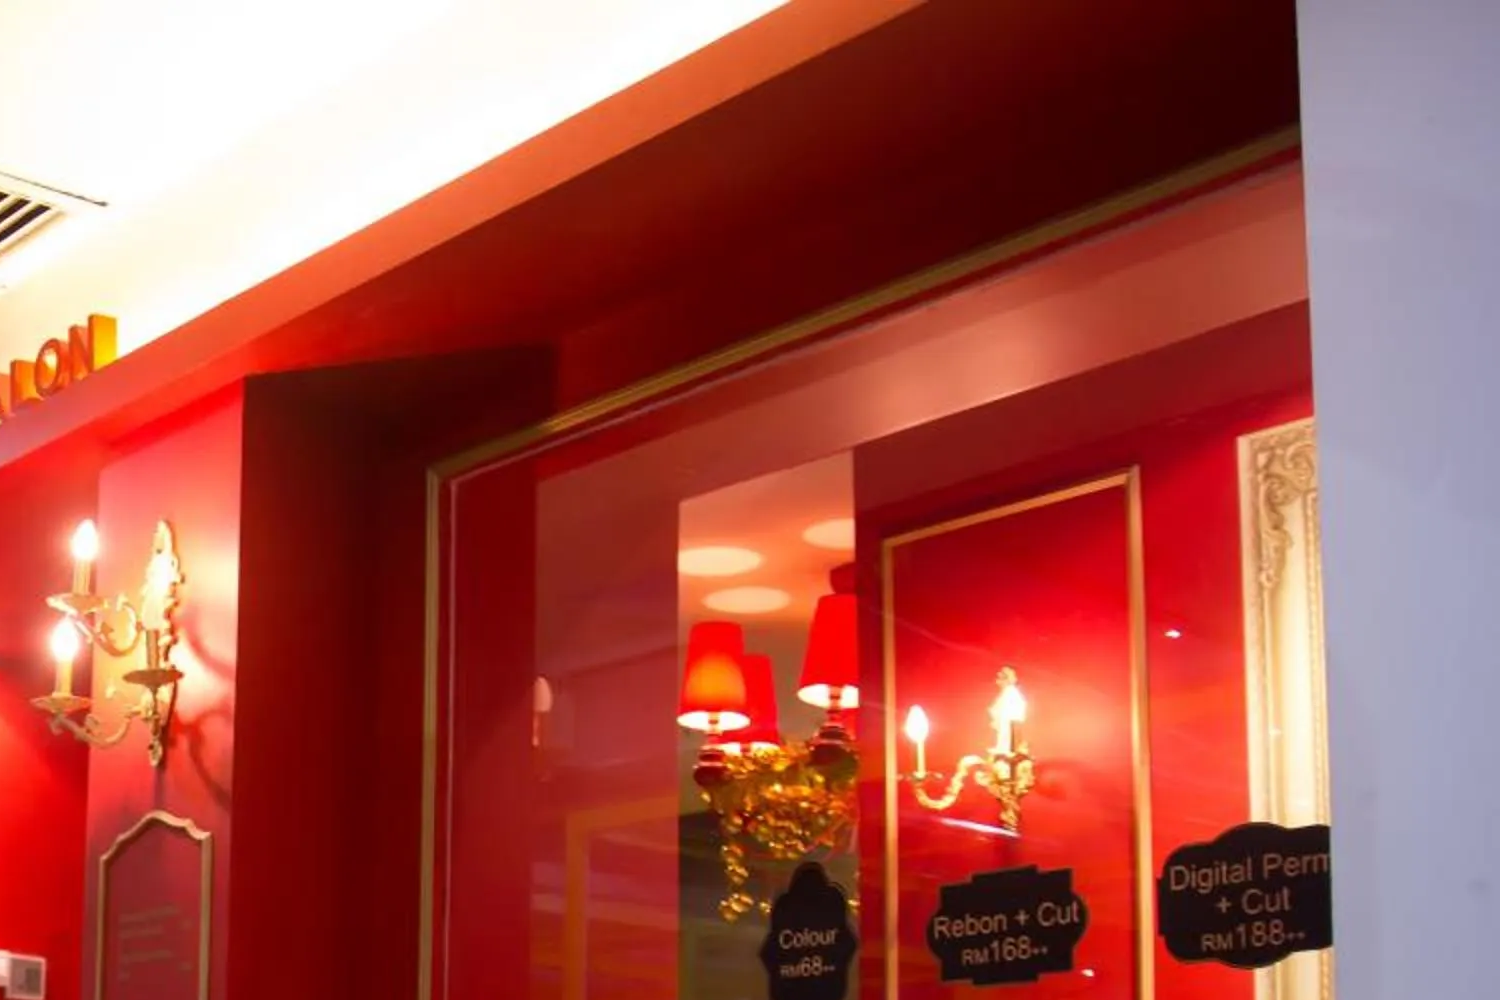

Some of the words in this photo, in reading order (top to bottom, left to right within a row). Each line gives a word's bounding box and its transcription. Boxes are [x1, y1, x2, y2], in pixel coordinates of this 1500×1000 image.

[1168, 856, 1253, 894] Digital
[1240, 886, 1292, 915] Cut
[932, 914, 1008, 939] Rebon
[1036, 901, 1080, 927] Cut
[778, 927, 839, 950] Colour
